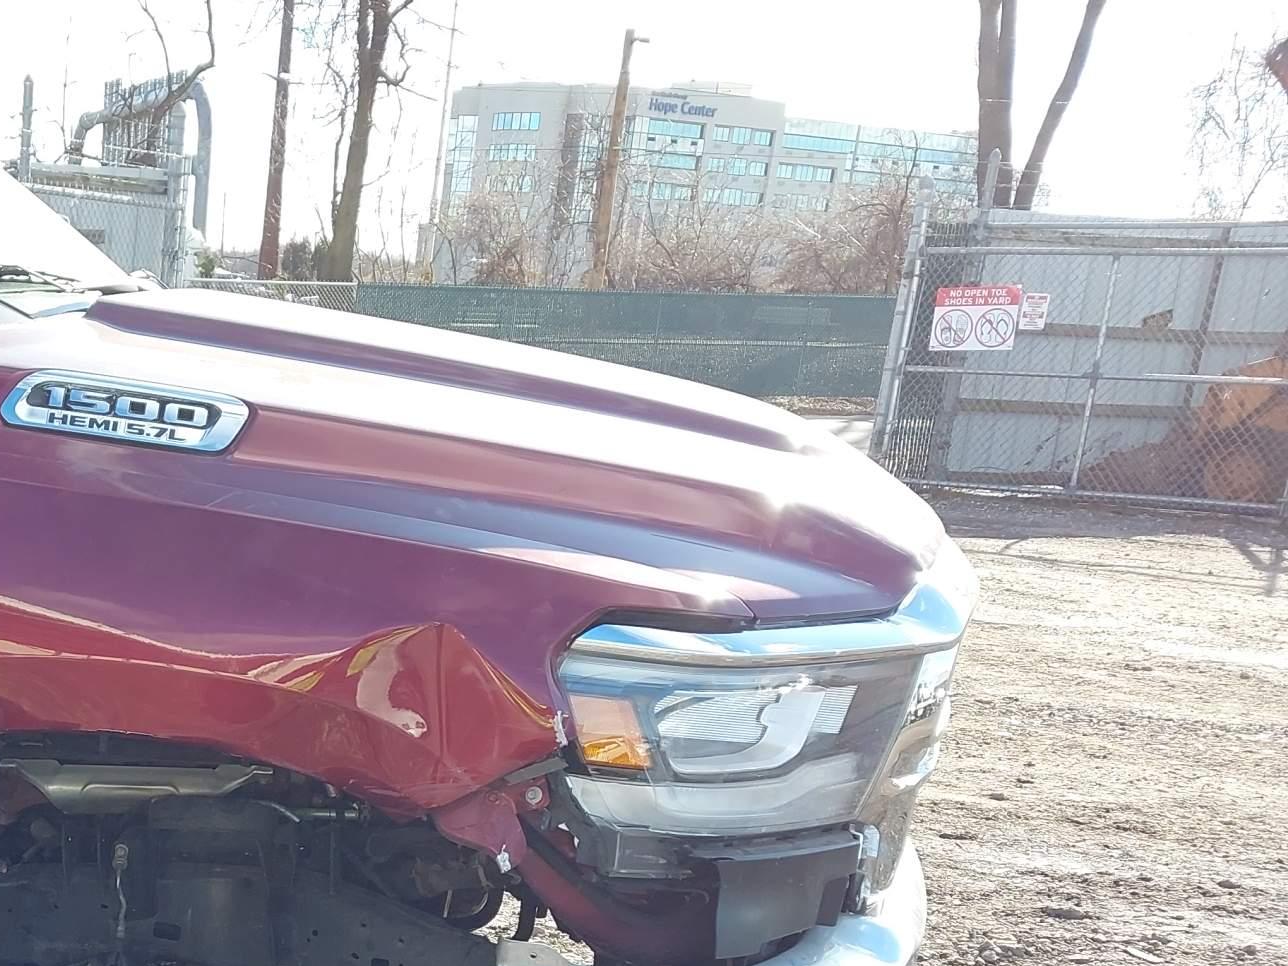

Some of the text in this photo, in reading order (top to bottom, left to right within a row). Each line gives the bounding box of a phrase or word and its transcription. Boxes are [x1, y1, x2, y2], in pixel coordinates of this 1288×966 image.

[648, 98, 718, 118] Hope Center
[944, 296, 1012, 306] SHOES IN YARD
[949, 288, 1008, 298] NO OPEN TOE
[43, 385, 210, 427] 1500
[48, 411, 187, 442] HEMI 5.7L
